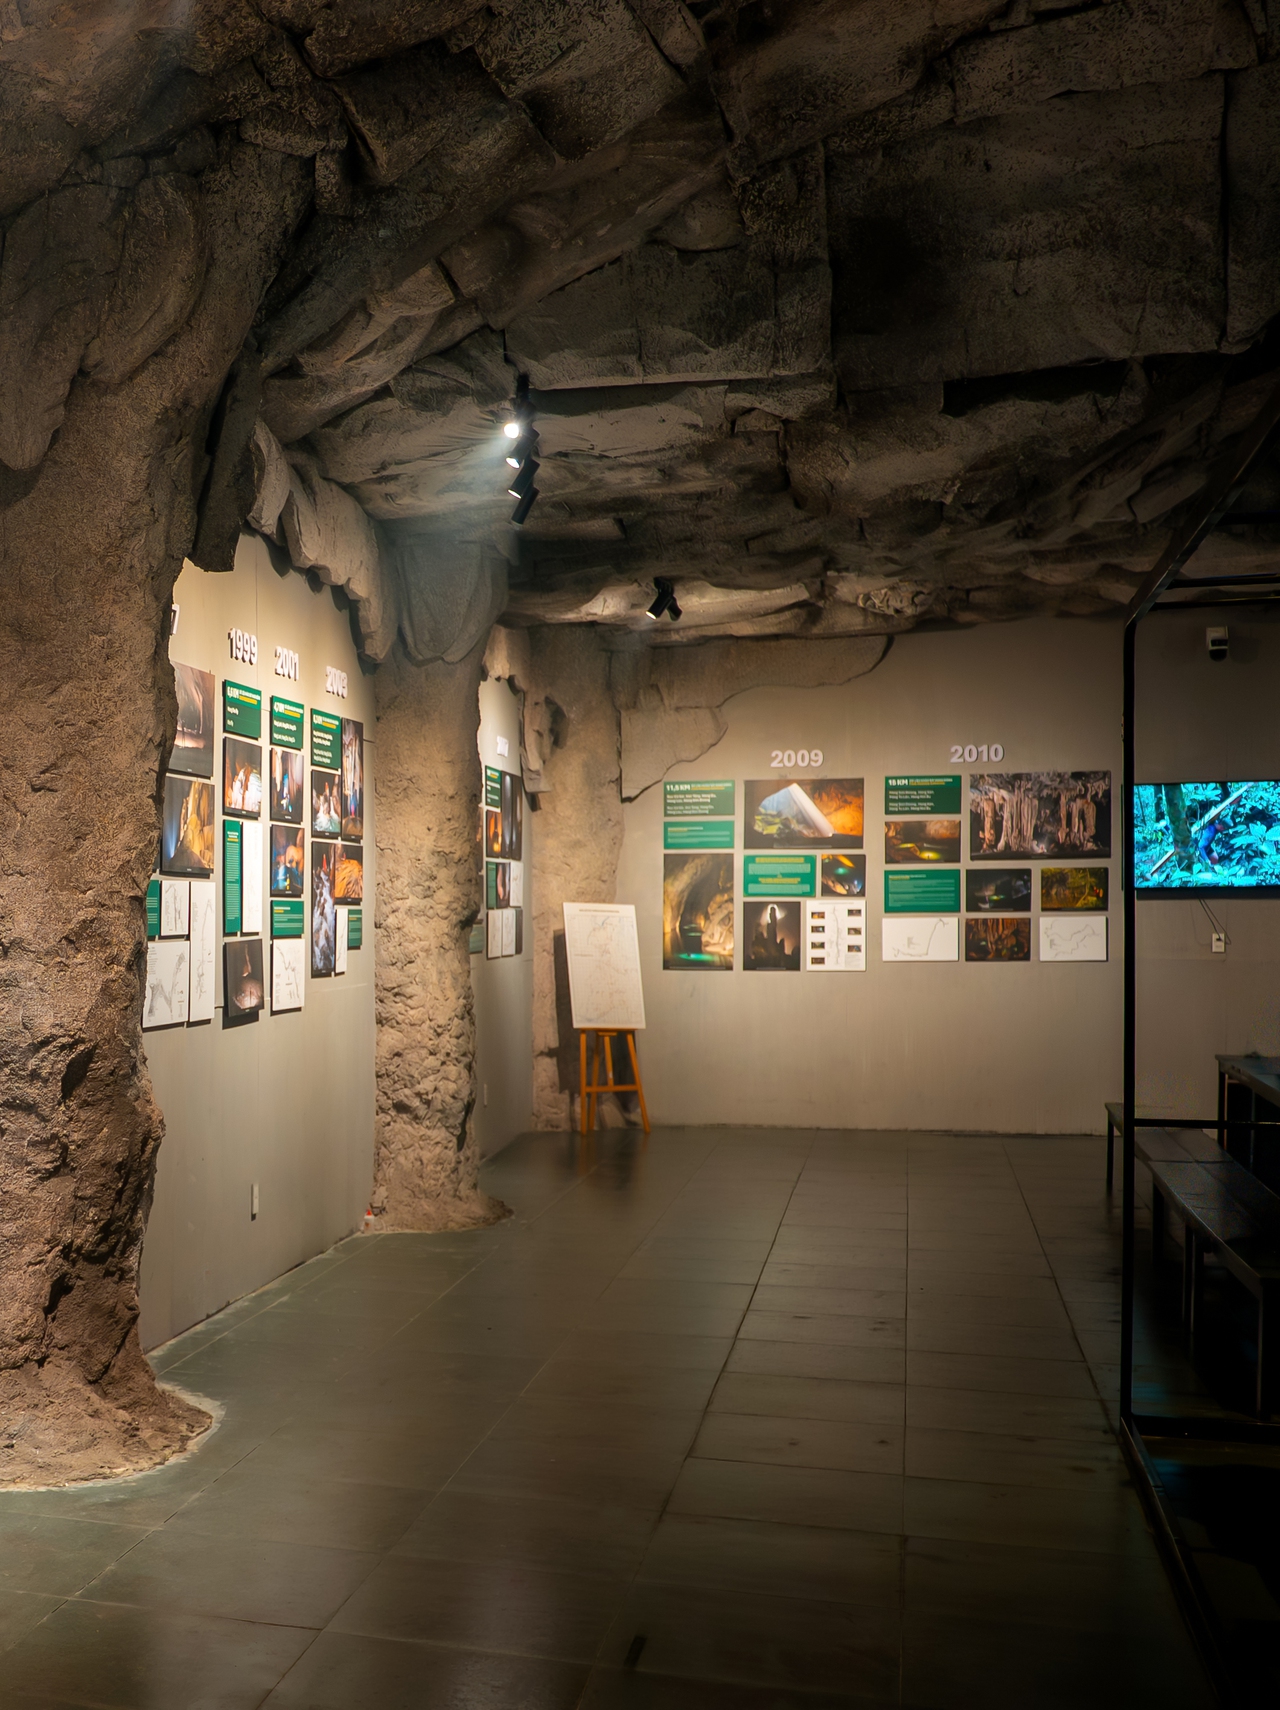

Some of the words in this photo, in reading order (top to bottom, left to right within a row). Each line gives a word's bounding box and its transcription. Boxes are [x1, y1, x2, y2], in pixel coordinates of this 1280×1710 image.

[228, 627, 258, 665] 1999
[275, 645, 299, 681] 2001
[770, 749, 824, 767] 2009
[950, 744, 1005, 763] 2010
